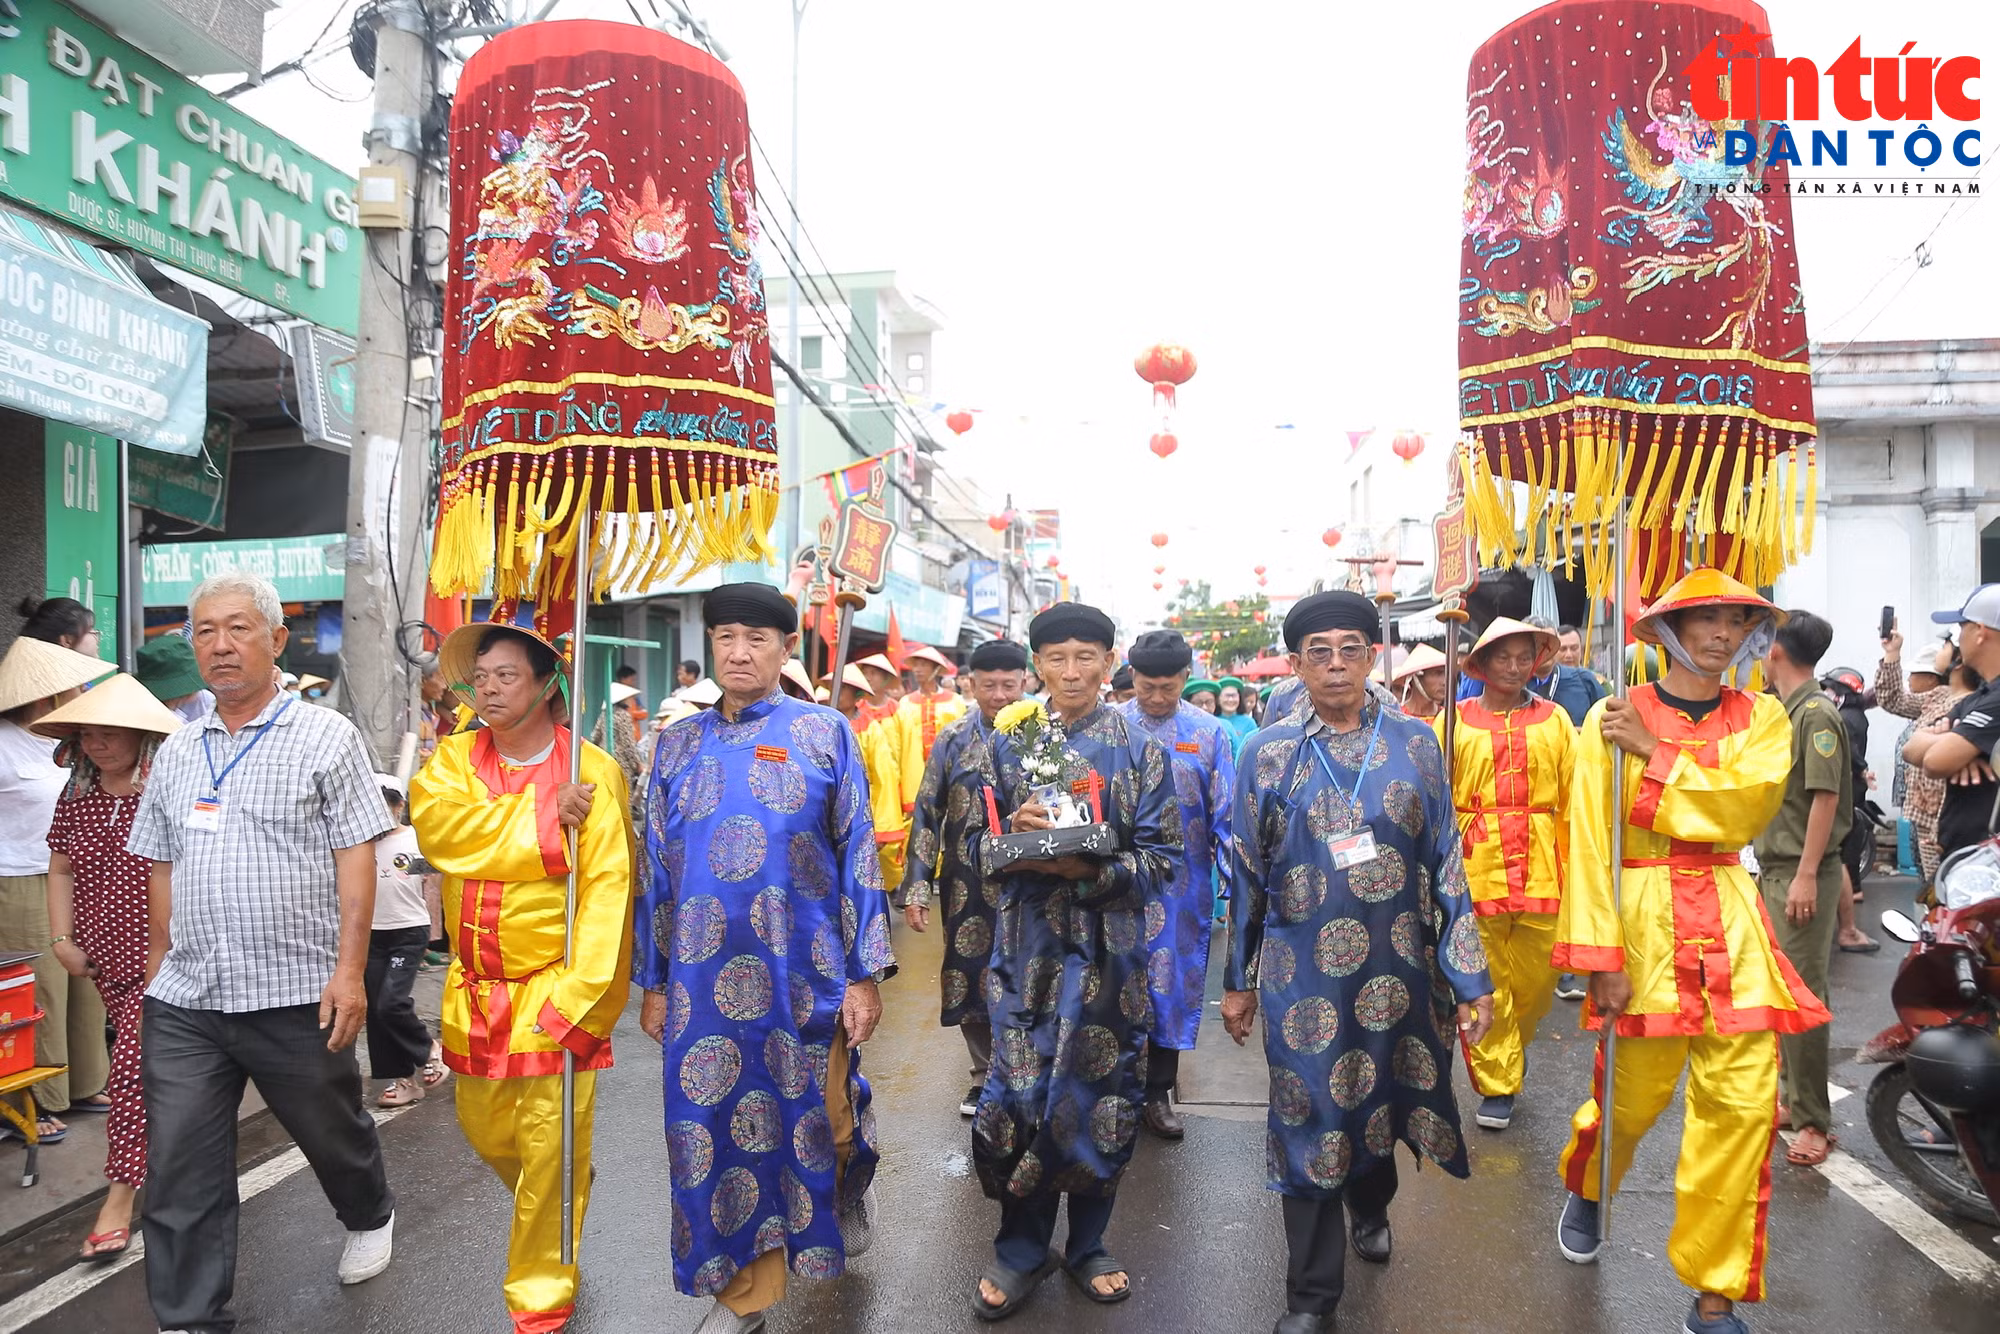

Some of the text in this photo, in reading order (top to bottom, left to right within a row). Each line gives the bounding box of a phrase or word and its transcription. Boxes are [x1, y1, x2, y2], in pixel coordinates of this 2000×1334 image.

[47, 26, 164, 117] ĐẠT
[72, 110, 326, 289] KHÁNH
[127, 218, 167, 252] HUỲNH
[51, 278, 111, 340] BÌNH
[118, 309, 189, 370] KHÁNH
[101, 384, 148, 411] QUÀ
[63, 436, 99, 513] GIÁ
